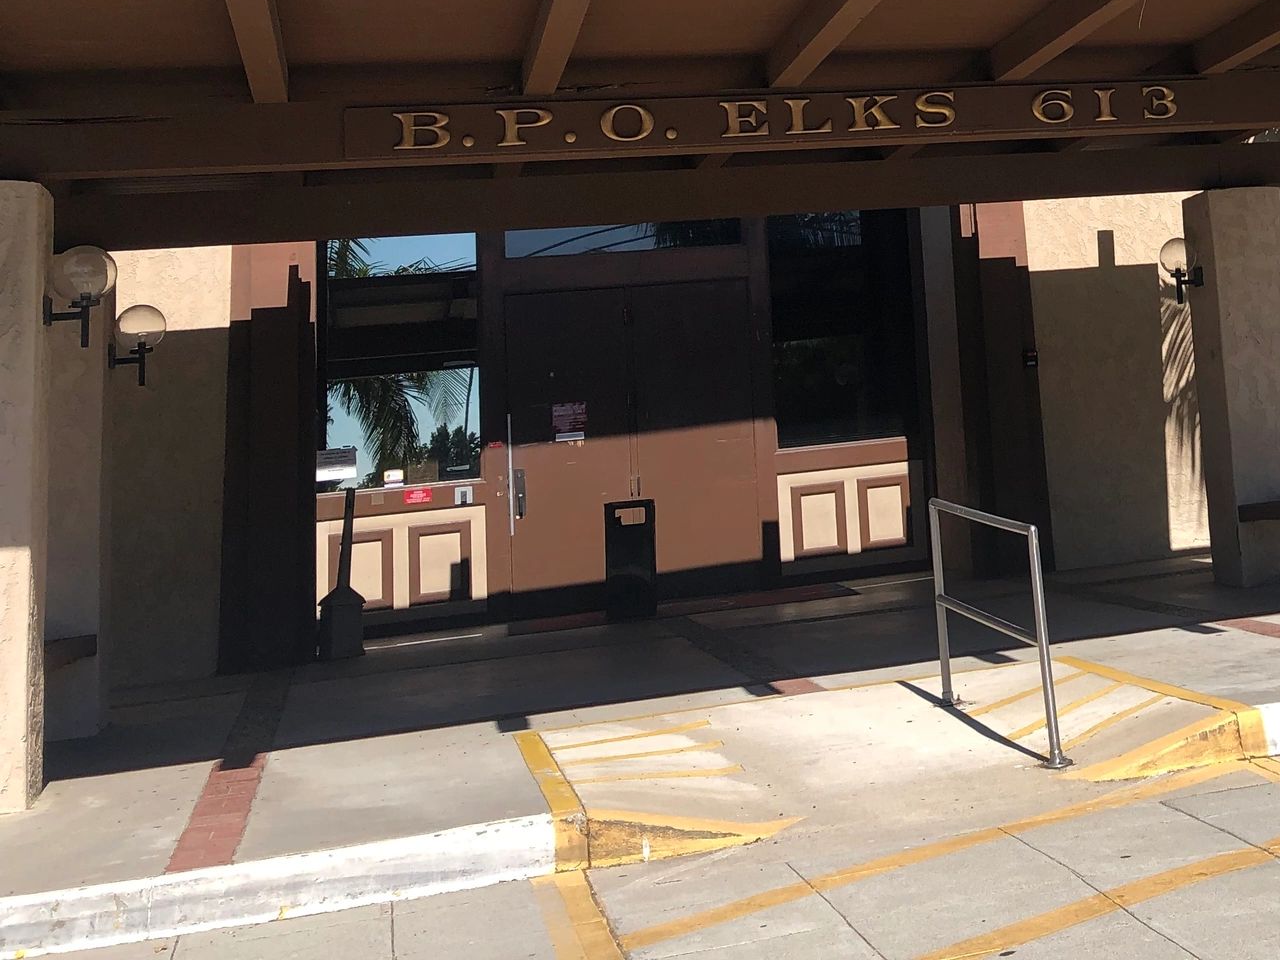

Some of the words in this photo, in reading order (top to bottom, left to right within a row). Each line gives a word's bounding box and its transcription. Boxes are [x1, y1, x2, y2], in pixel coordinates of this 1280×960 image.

[392, 104, 678, 150] B.P.O.
[719, 91, 956, 137] ELKS
[1031, 86, 1178, 124] 613
